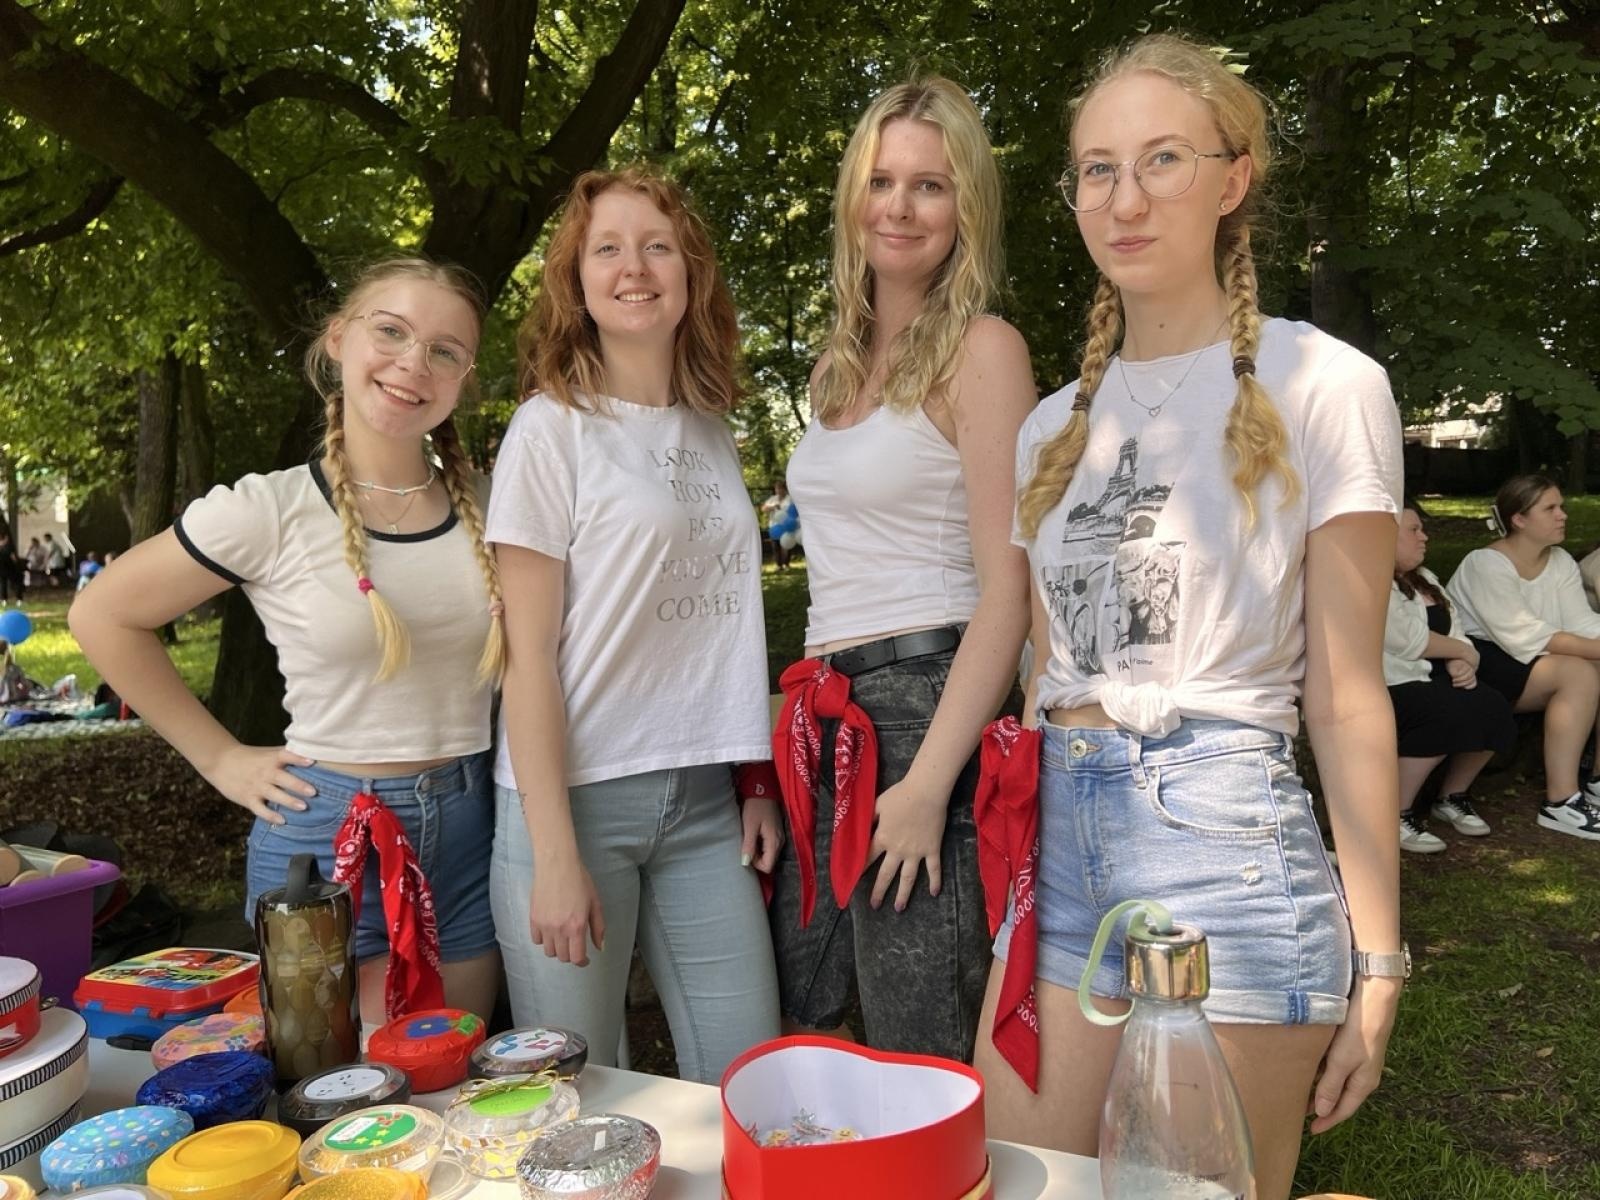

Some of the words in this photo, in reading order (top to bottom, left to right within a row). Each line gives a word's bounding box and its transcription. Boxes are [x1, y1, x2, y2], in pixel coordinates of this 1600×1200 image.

[649, 446, 713, 472] LOOK
[668, 479, 720, 503] HOW
[656, 591, 740, 622] COME
